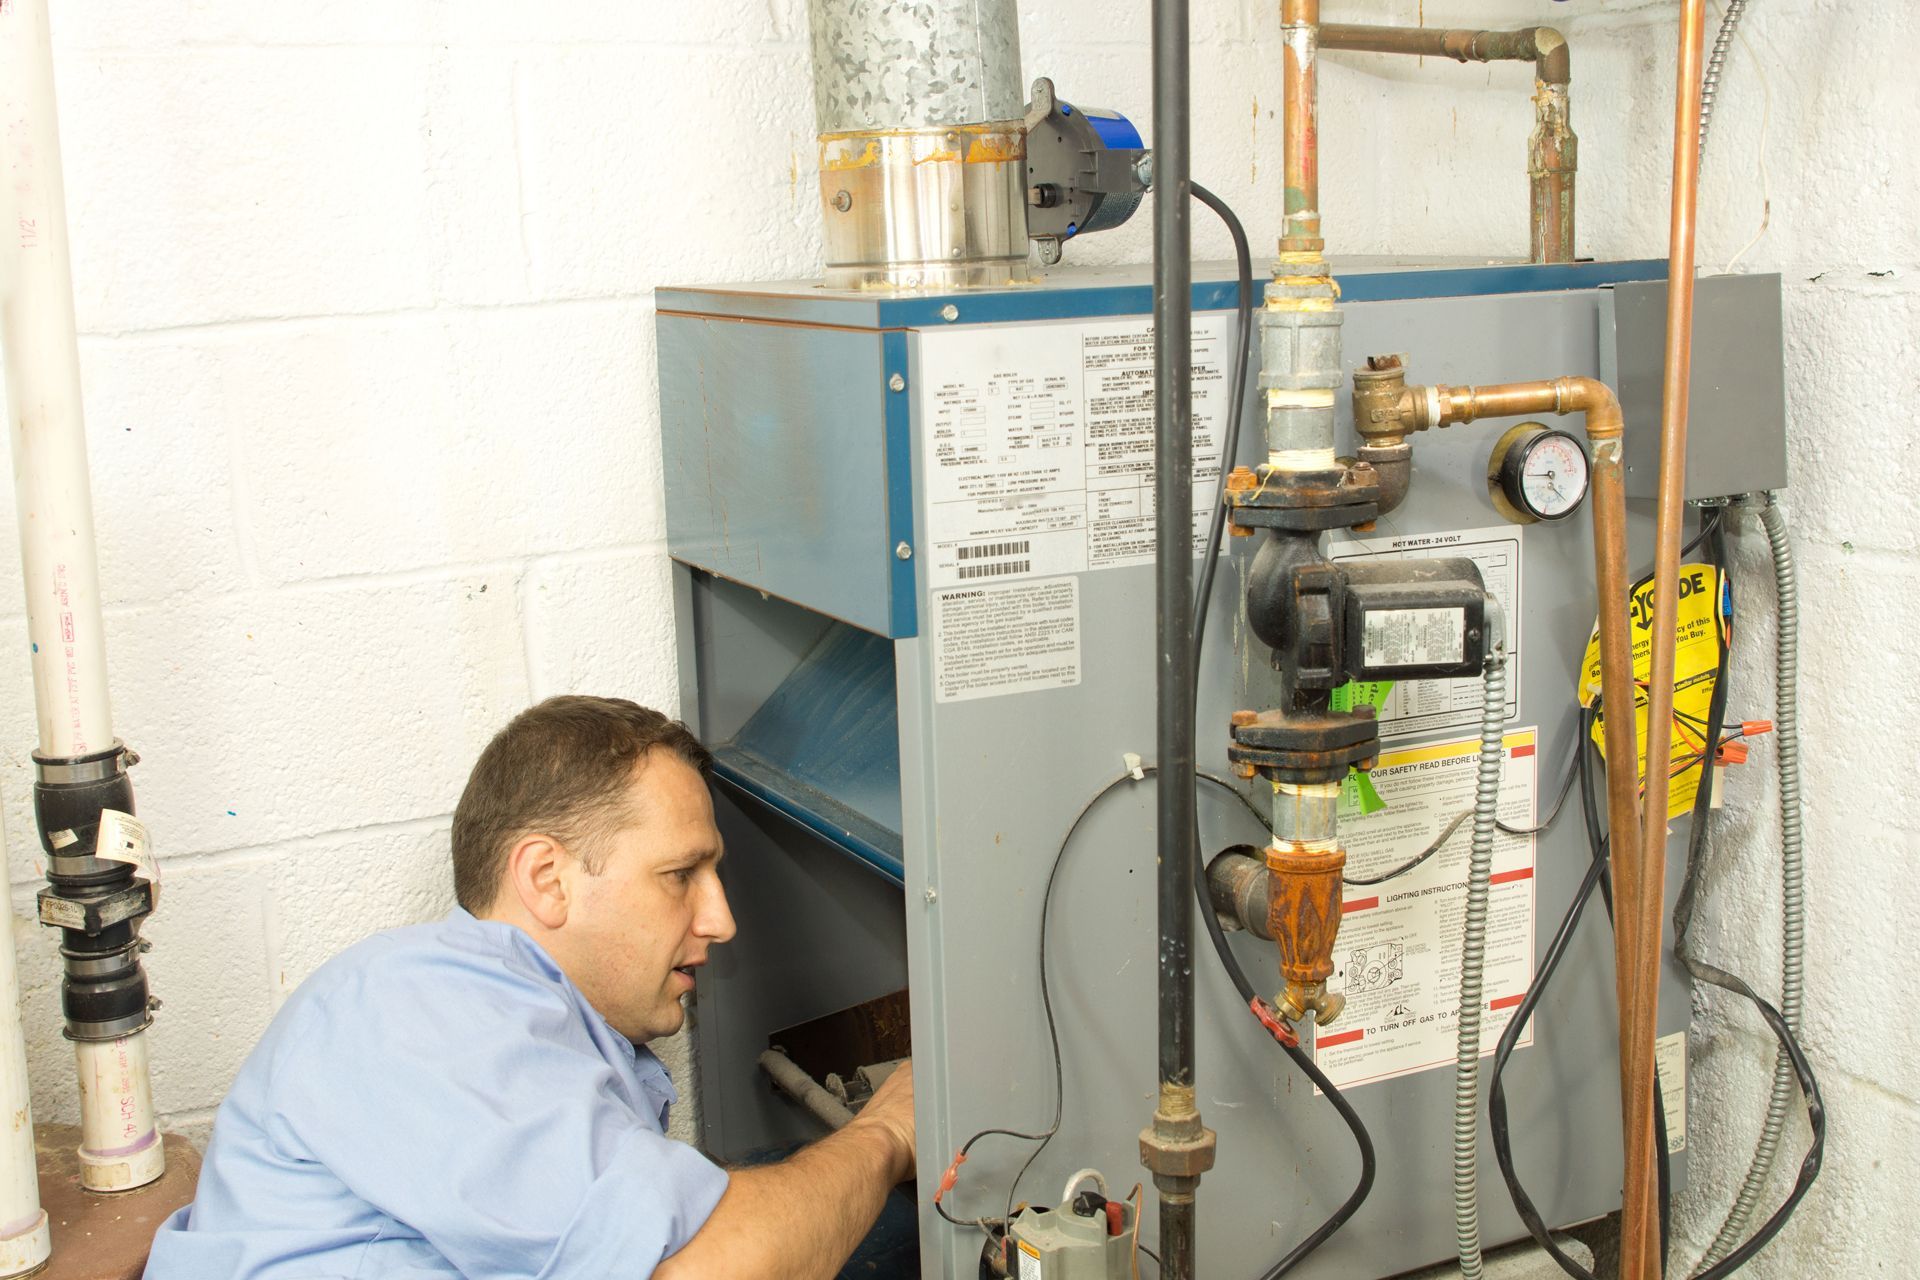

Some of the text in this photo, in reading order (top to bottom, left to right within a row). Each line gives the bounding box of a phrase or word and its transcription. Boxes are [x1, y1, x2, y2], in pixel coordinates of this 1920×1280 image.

[1122, 368, 1154, 376] AUTOMAT
[1392, 540, 1407, 548] HOT
[1407, 538, 1431, 547] WATER
[1444, 535, 1462, 543] VOLT
[942, 590, 985, 600] WARNING:
[1696, 617, 1711, 626] this
[1691, 628, 1706, 639] Buy.
[1632, 640, 1649, 649] nergy
[1632, 648, 1650, 660] thers
[1371, 770, 1387, 778] OUR
[1389, 765, 1417, 775] SAFETY
[1419, 762, 1440, 770] READ
[1441, 757, 1471, 767] BEFORE
[1386, 881, 1468, 903] LIGHTING INSTRUCTION
[1366, 1012, 1447, 1035] TO TURN OFF GAS TO
[120, 1095, 136, 1120] SCH
[123, 1123, 138, 1140] 40
